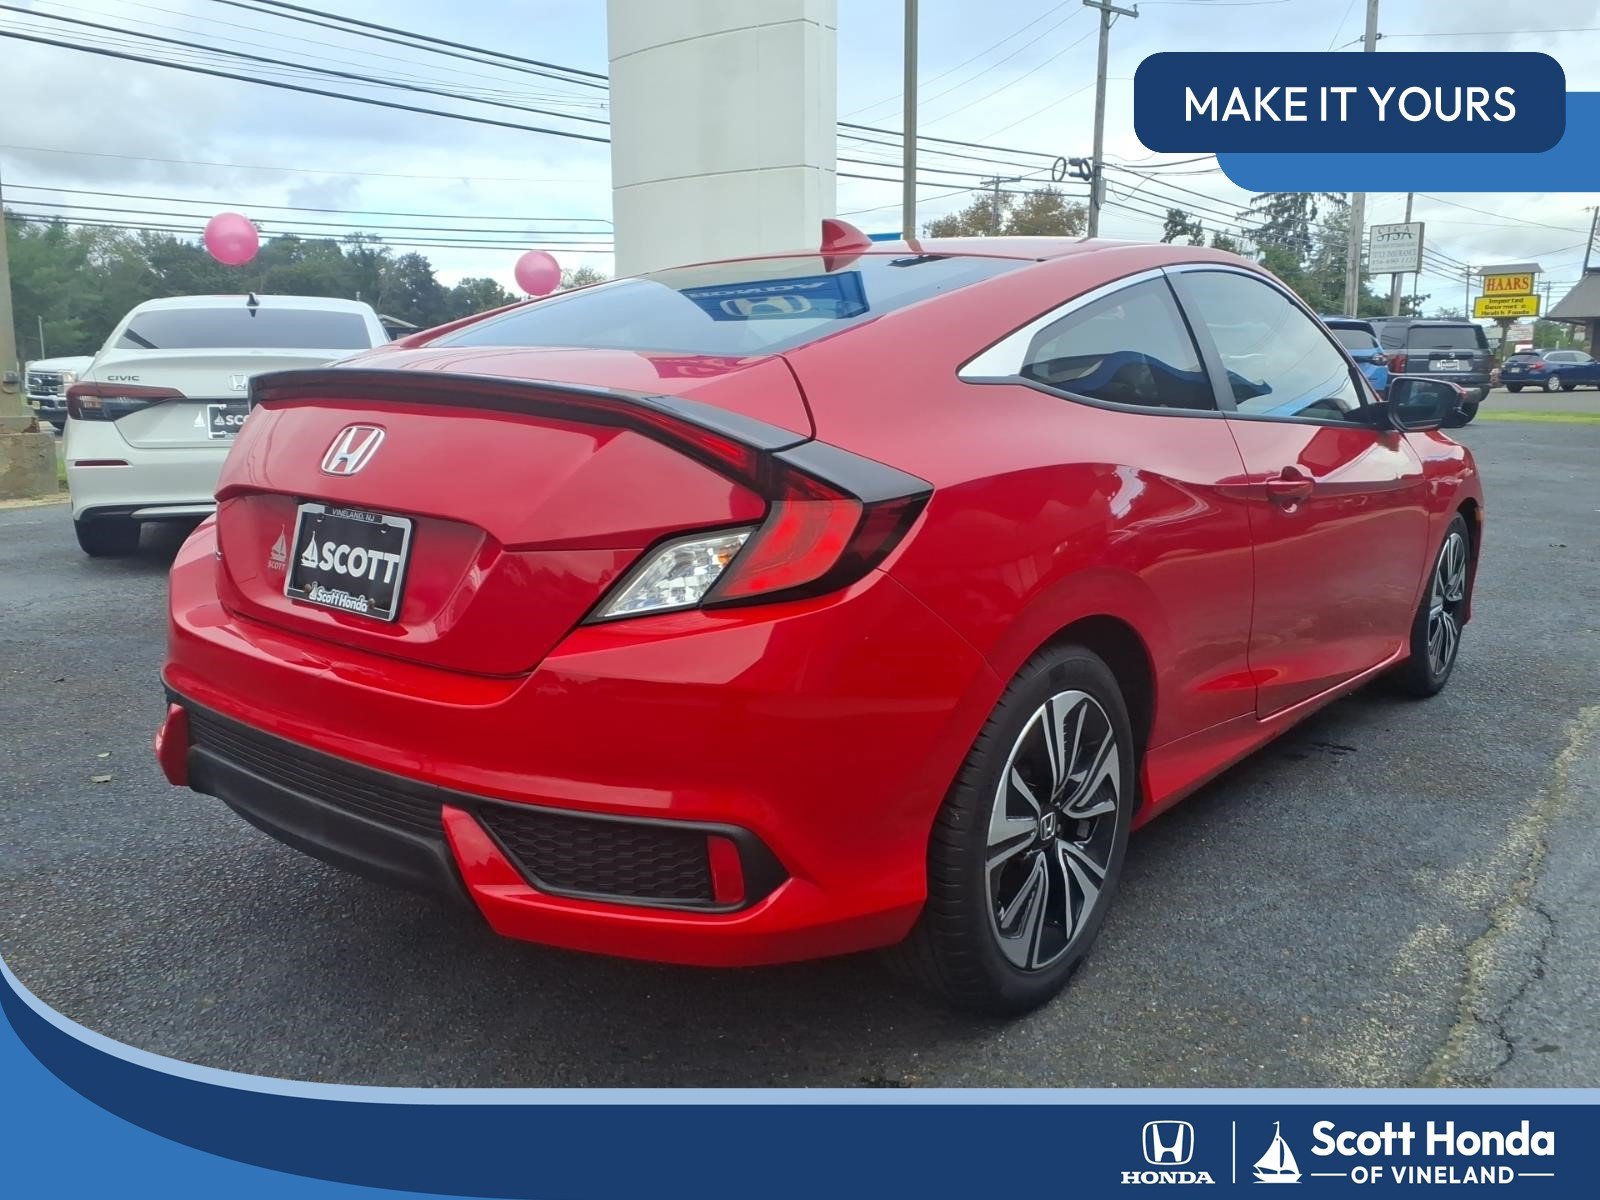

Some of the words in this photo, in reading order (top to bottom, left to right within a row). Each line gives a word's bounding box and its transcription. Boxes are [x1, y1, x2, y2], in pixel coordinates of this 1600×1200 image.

[1487, 277, 1529, 291] HAARS
[365, 513, 375, 522] NJ
[267, 560, 286, 571] SCOTT
[319, 541, 401, 584] SCOTT
[316, 588, 340, 606] Scott
[338, 592, 368, 612] Honda
